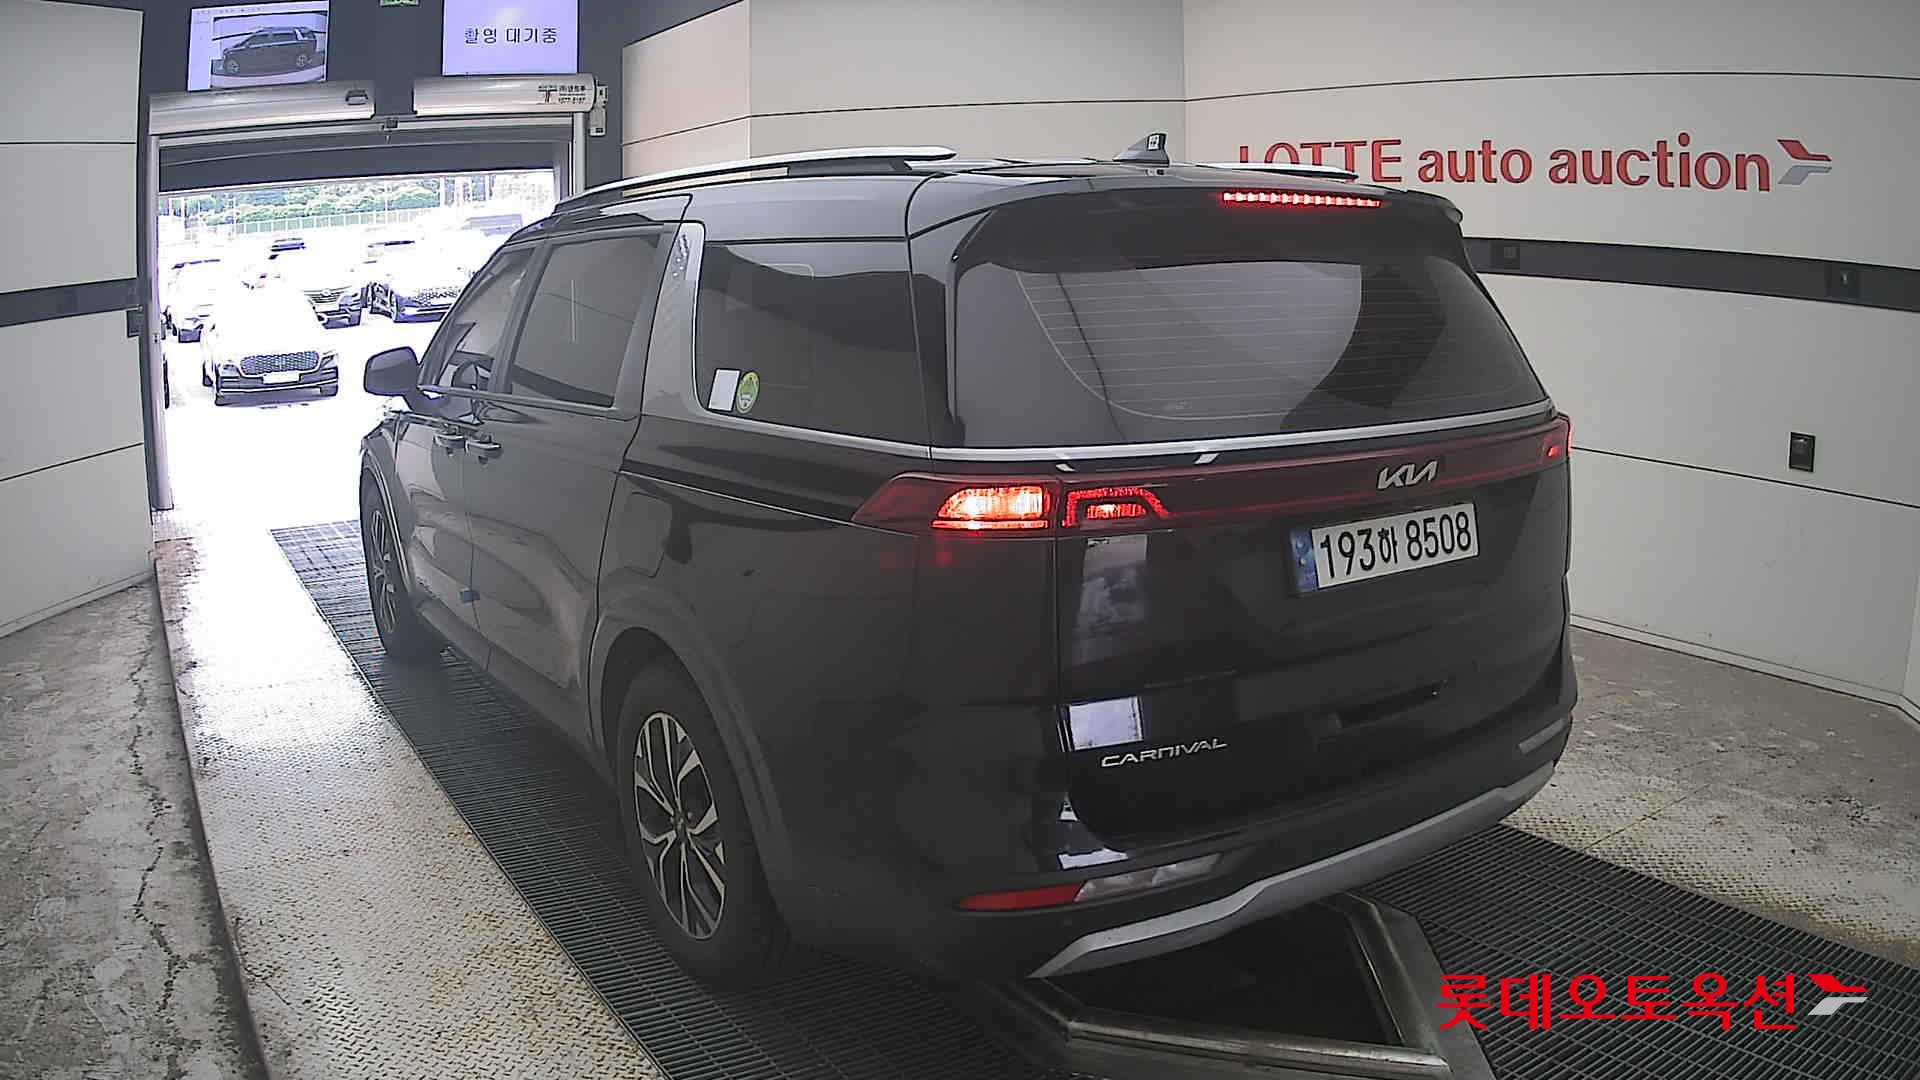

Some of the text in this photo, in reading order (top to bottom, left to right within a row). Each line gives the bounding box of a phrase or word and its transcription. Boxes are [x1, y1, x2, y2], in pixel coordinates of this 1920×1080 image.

[506, 27, 557, 44] 대기중
[1417, 140, 1533, 184] auto
[1549, 132, 1771, 192] auction
[1319, 511, 1472, 579] 193하 8508
[1101, 738, 1228, 767] CARNIVAL
